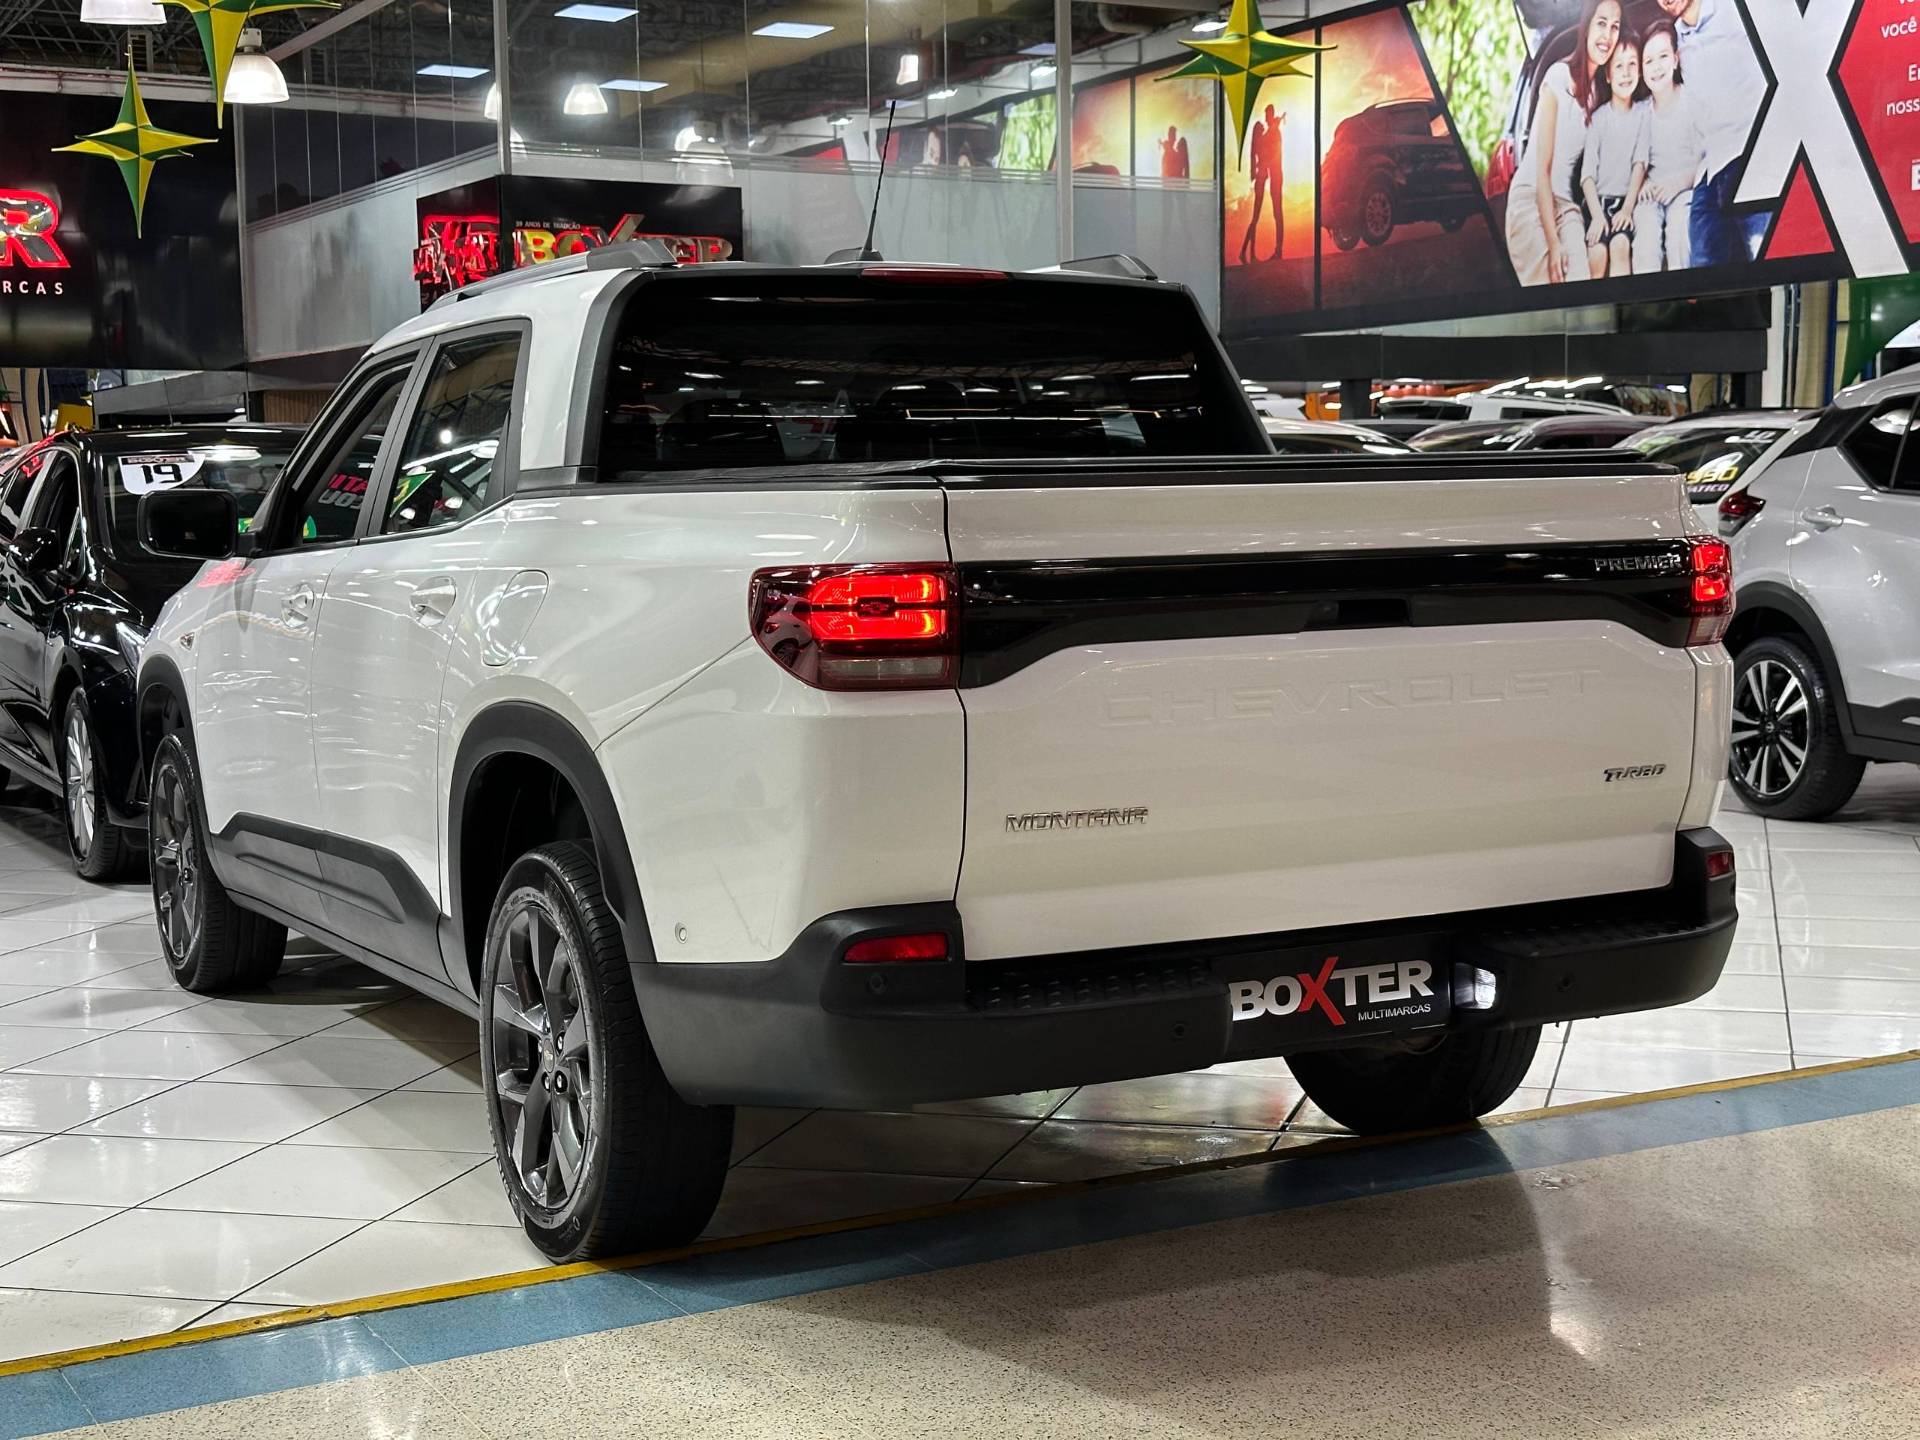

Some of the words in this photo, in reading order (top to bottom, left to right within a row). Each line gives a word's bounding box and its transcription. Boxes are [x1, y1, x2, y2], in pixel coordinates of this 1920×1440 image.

[1881, 16, 1917, 38] você
[140, 463, 183, 485] 19
[1594, 553, 1682, 572] PREMIER
[1101, 668, 1601, 727] CHEVROLET
[1005, 806, 1149, 833] MONTANA
[1227, 956, 1435, 1027] BOXTER
[1358, 1003, 1431, 1021] MULTIMARCAS
